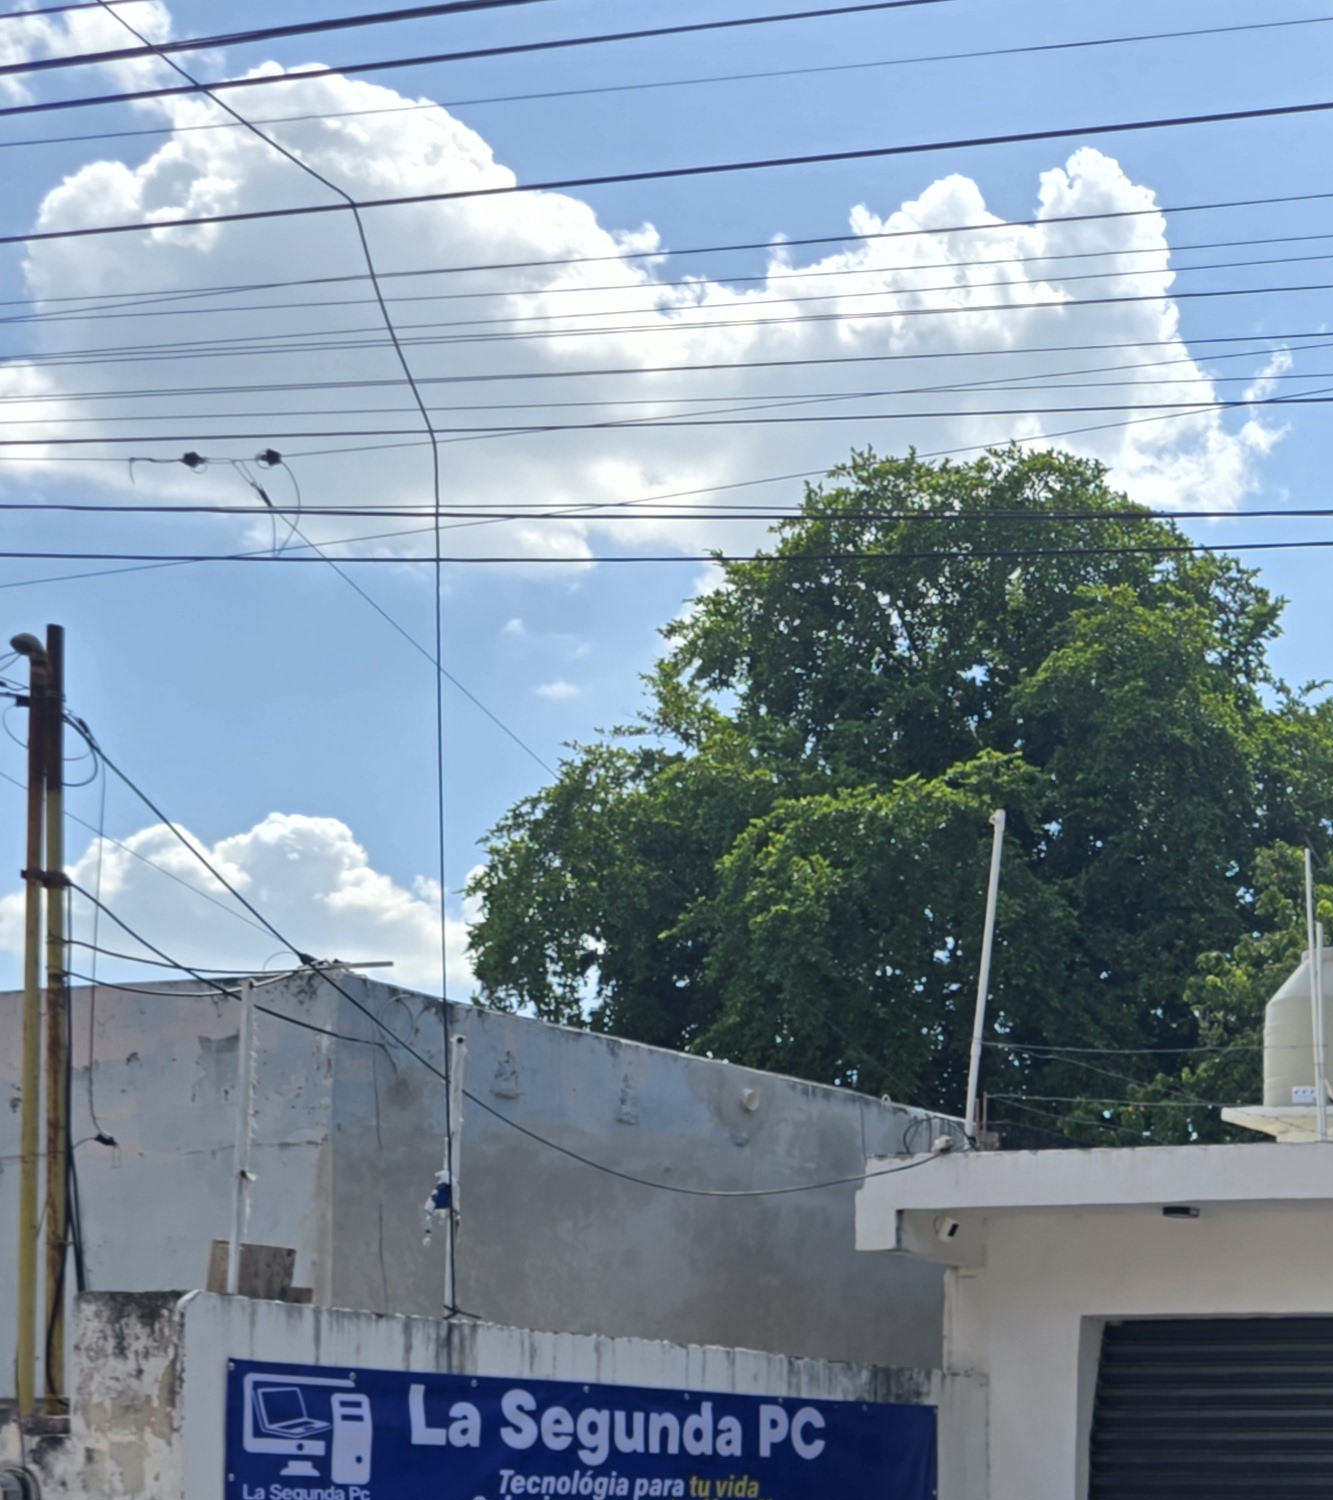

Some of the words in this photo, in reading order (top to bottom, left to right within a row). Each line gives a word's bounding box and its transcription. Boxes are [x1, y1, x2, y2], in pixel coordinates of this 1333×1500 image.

[409, 1384, 481, 1447] La
[500, 1389, 742, 1466] Segunda
[759, 1404, 826, 1460] PC
[243, 1484, 265, 1500] La
[499, 1469, 630, 1500] Tecnológia
[633, 1475, 685, 1500] para
[690, 1476, 714, 1497] tu
[716, 1474, 760, 1498] vida
